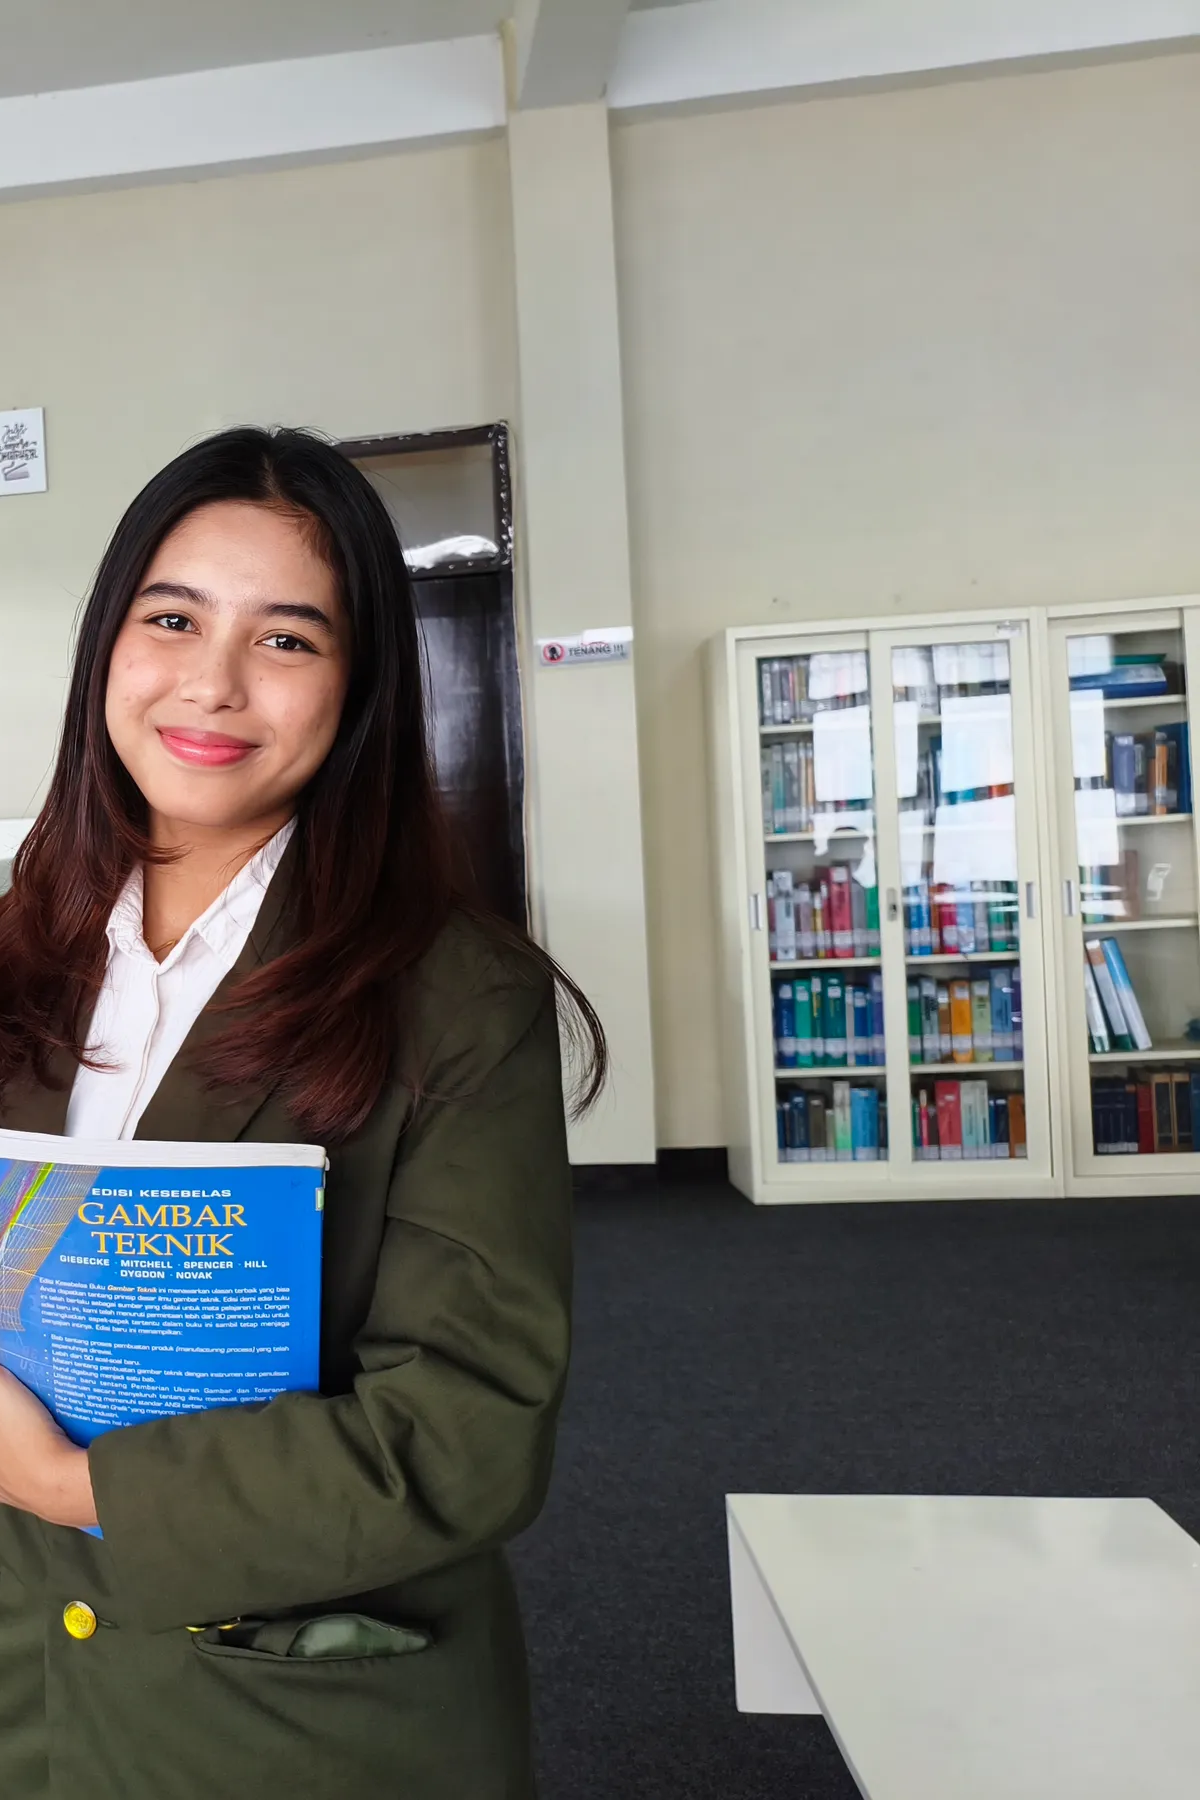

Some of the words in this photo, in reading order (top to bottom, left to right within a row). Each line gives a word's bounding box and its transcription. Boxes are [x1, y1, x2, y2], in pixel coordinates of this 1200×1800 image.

[568, 645, 611, 656] TENANG
[92, 1188, 133, 1197] EDISI
[140, 1189, 231, 1197] KESEBELAS
[77, 1202, 247, 1227] GAMBAR
[91, 1231, 234, 1256] TEKNIK
[59, 1255, 110, 1266] GIESECKE
[120, 1259, 173, 1269] MITCHELL
[183, 1261, 233, 1269] SPENCER
[244, 1260, 268, 1268] HILL
[120, 1270, 165, 1279] DYGDON
[176, 1271, 213, 1280] NOVAK
